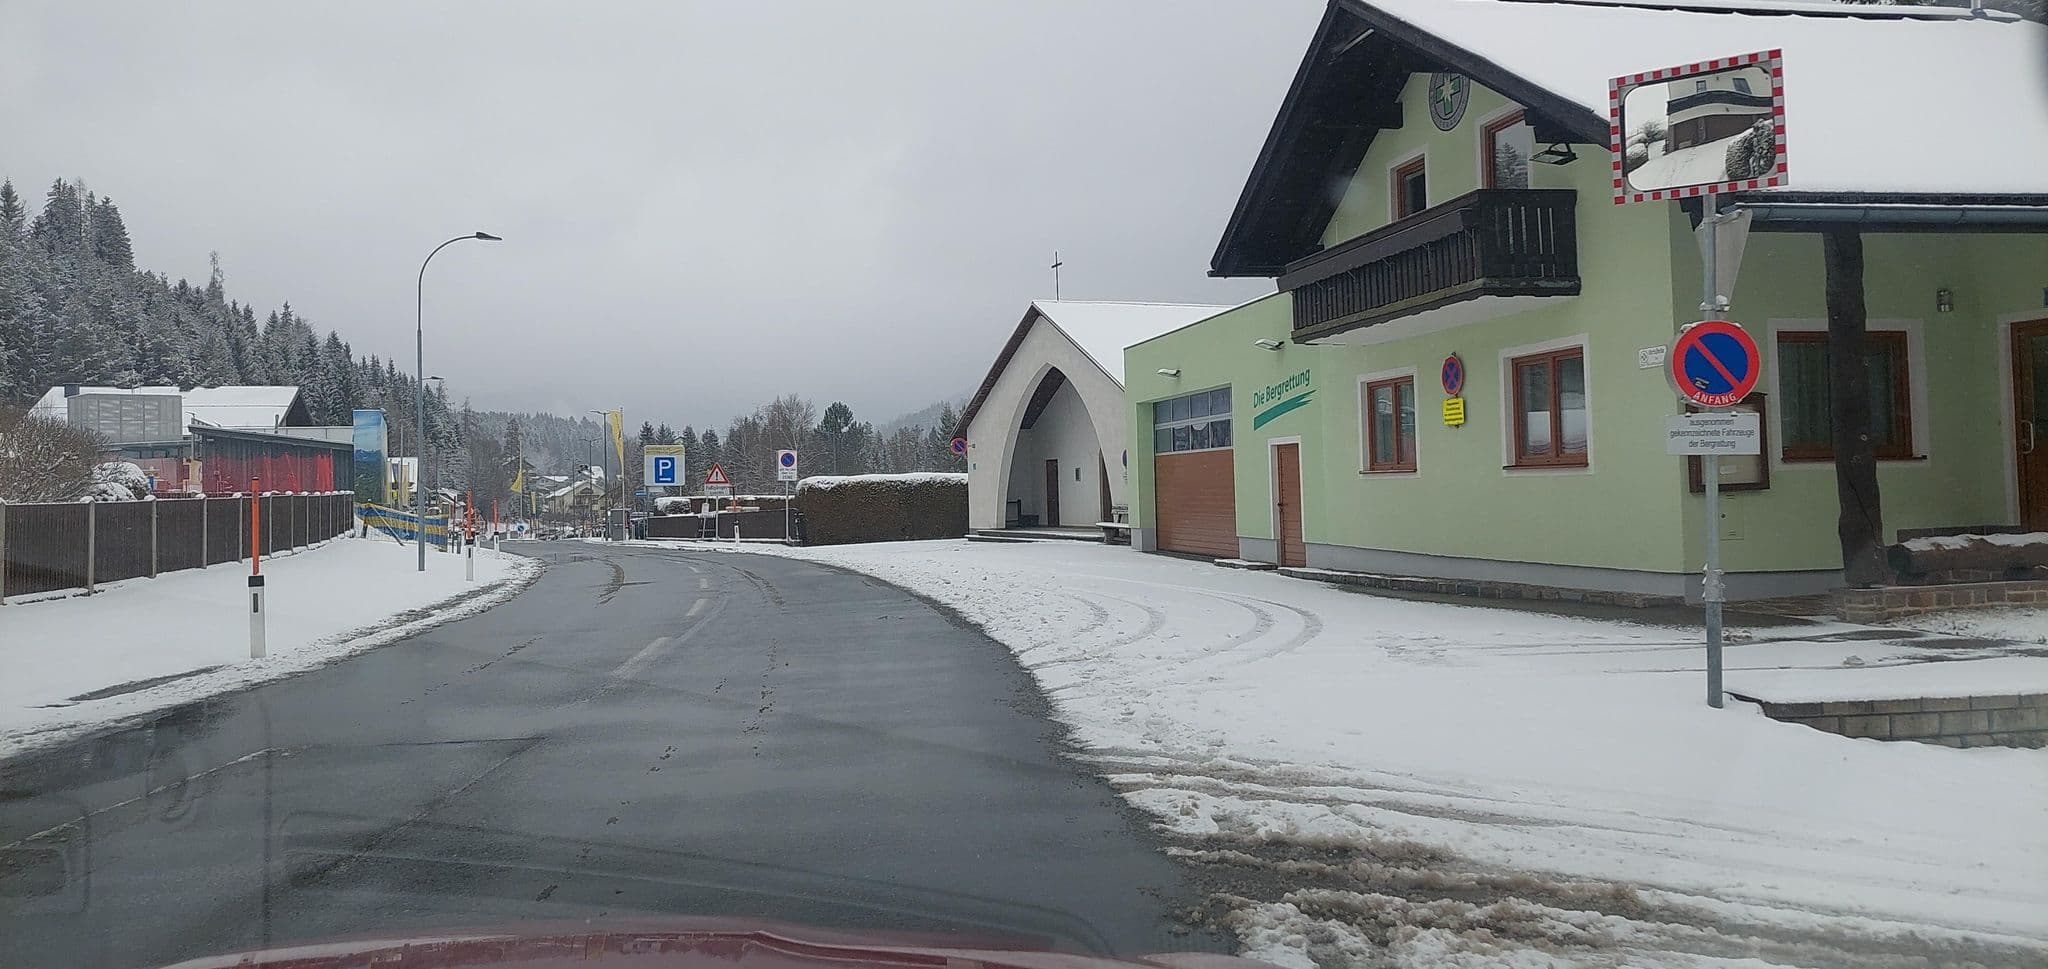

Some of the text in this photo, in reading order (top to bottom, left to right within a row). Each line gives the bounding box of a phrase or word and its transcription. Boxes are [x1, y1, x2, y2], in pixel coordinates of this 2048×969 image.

[1254, 368, 1310, 408] Die Bergrettung
[1693, 391, 1736, 404] ANFANG
[1689, 419, 1734, 427] ausgenommen
[1670, 428, 1755, 438] gekennzeichnete Fahrzeuge
[1689, 440, 1736, 449] der Bergrettung
[659, 460, 671, 476] P
